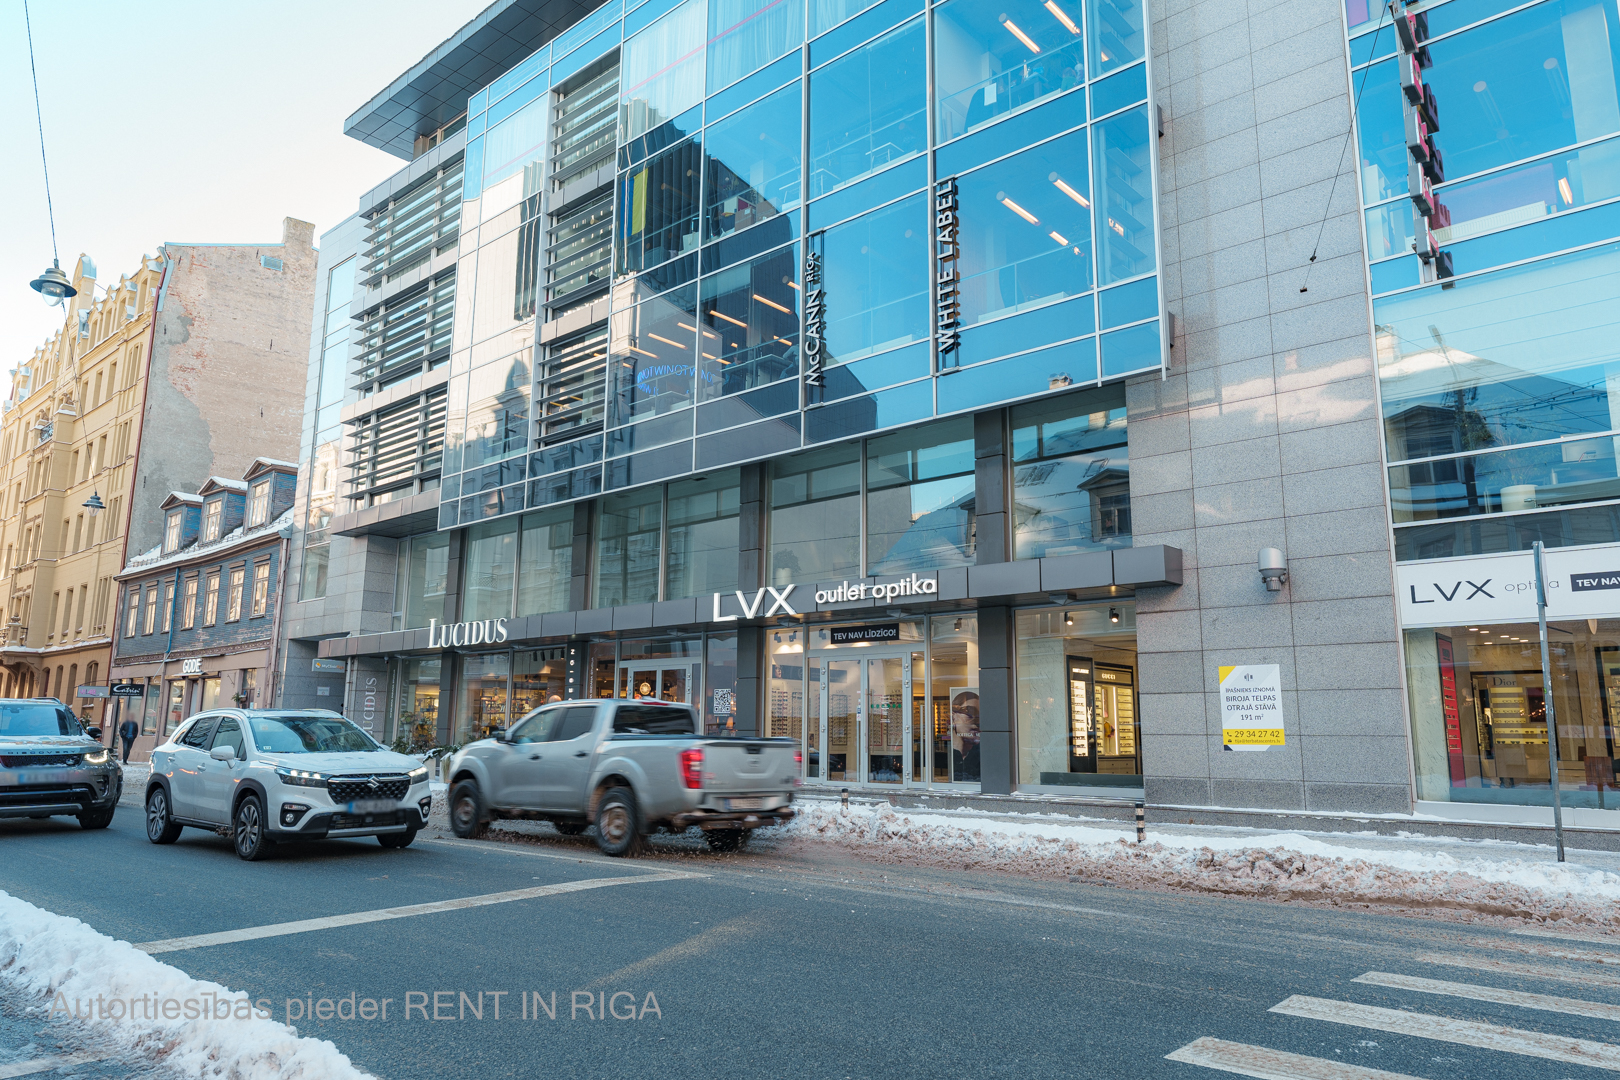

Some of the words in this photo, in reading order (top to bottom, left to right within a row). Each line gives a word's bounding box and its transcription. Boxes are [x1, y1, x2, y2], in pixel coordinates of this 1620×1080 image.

[936, 180, 954, 260] LABEL
[805, 252, 814, 282] RĪGA
[937, 268, 955, 352] WHITE
[1410, 578, 1496, 604] LVX
[1504, 580, 1560, 594] optia
[1576, 578, 1598, 587] TEV
[713, 584, 797, 622] LVX
[815, 580, 866, 604] outlet
[872, 572, 937, 603] optika
[427, 618, 508, 648] LUCIDUS
[848, 631, 864, 639] NAV
[183, 659, 202, 674] GODE
[1492, 677, 1516, 686] Dior
